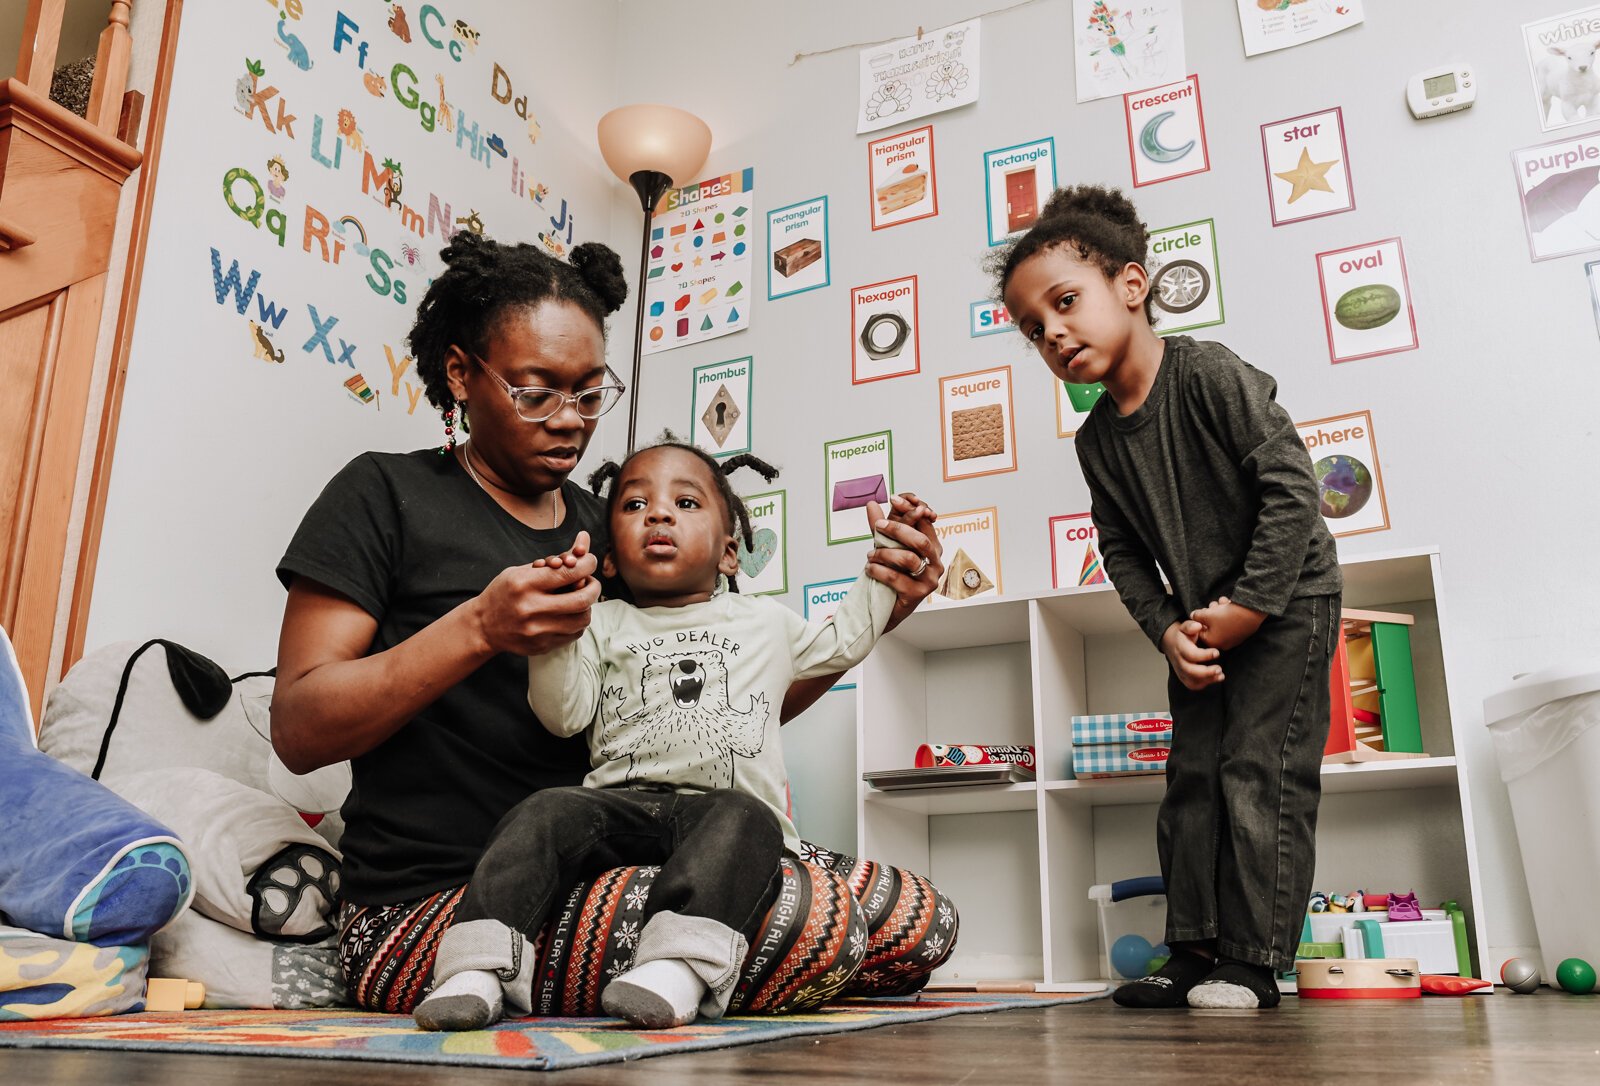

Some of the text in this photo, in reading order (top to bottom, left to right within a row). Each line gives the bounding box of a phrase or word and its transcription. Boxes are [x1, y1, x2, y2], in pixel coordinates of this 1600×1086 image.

[1539, 17, 1600, 46] white
[1131, 85, 1193, 111] crescent
[1283, 123, 1321, 143] star
[875, 135, 926, 156] triangular
[886, 149, 915, 166] prism
[992, 147, 1049, 168] rectangle
[1525, 144, 1600, 177] purple
[669, 180, 731, 208] Shapes
[772, 205, 822, 225] rectangular
[785, 219, 809, 233] prism
[1152, 231, 1201, 254] circle
[1339, 249, 1383, 274] oval
[857, 286, 911, 305] hexagon
[699, 366, 747, 384] rhombus
[951, 378, 1001, 398] square
[830, 439, 886, 460] trapezoid
[1303, 426, 1364, 452] phere
[626, 631, 741, 656] HUG DEALER
[999, 751, 1035, 767] Cookie
[774, 877, 797, 926] SLEIGH
[557, 911, 572, 935] ALL
[765, 928, 782, 952] ALL
[549, 939, 564, 968] DAY
[374, 958, 398, 995] SLEIGH
[748, 957, 768, 983] DAY
